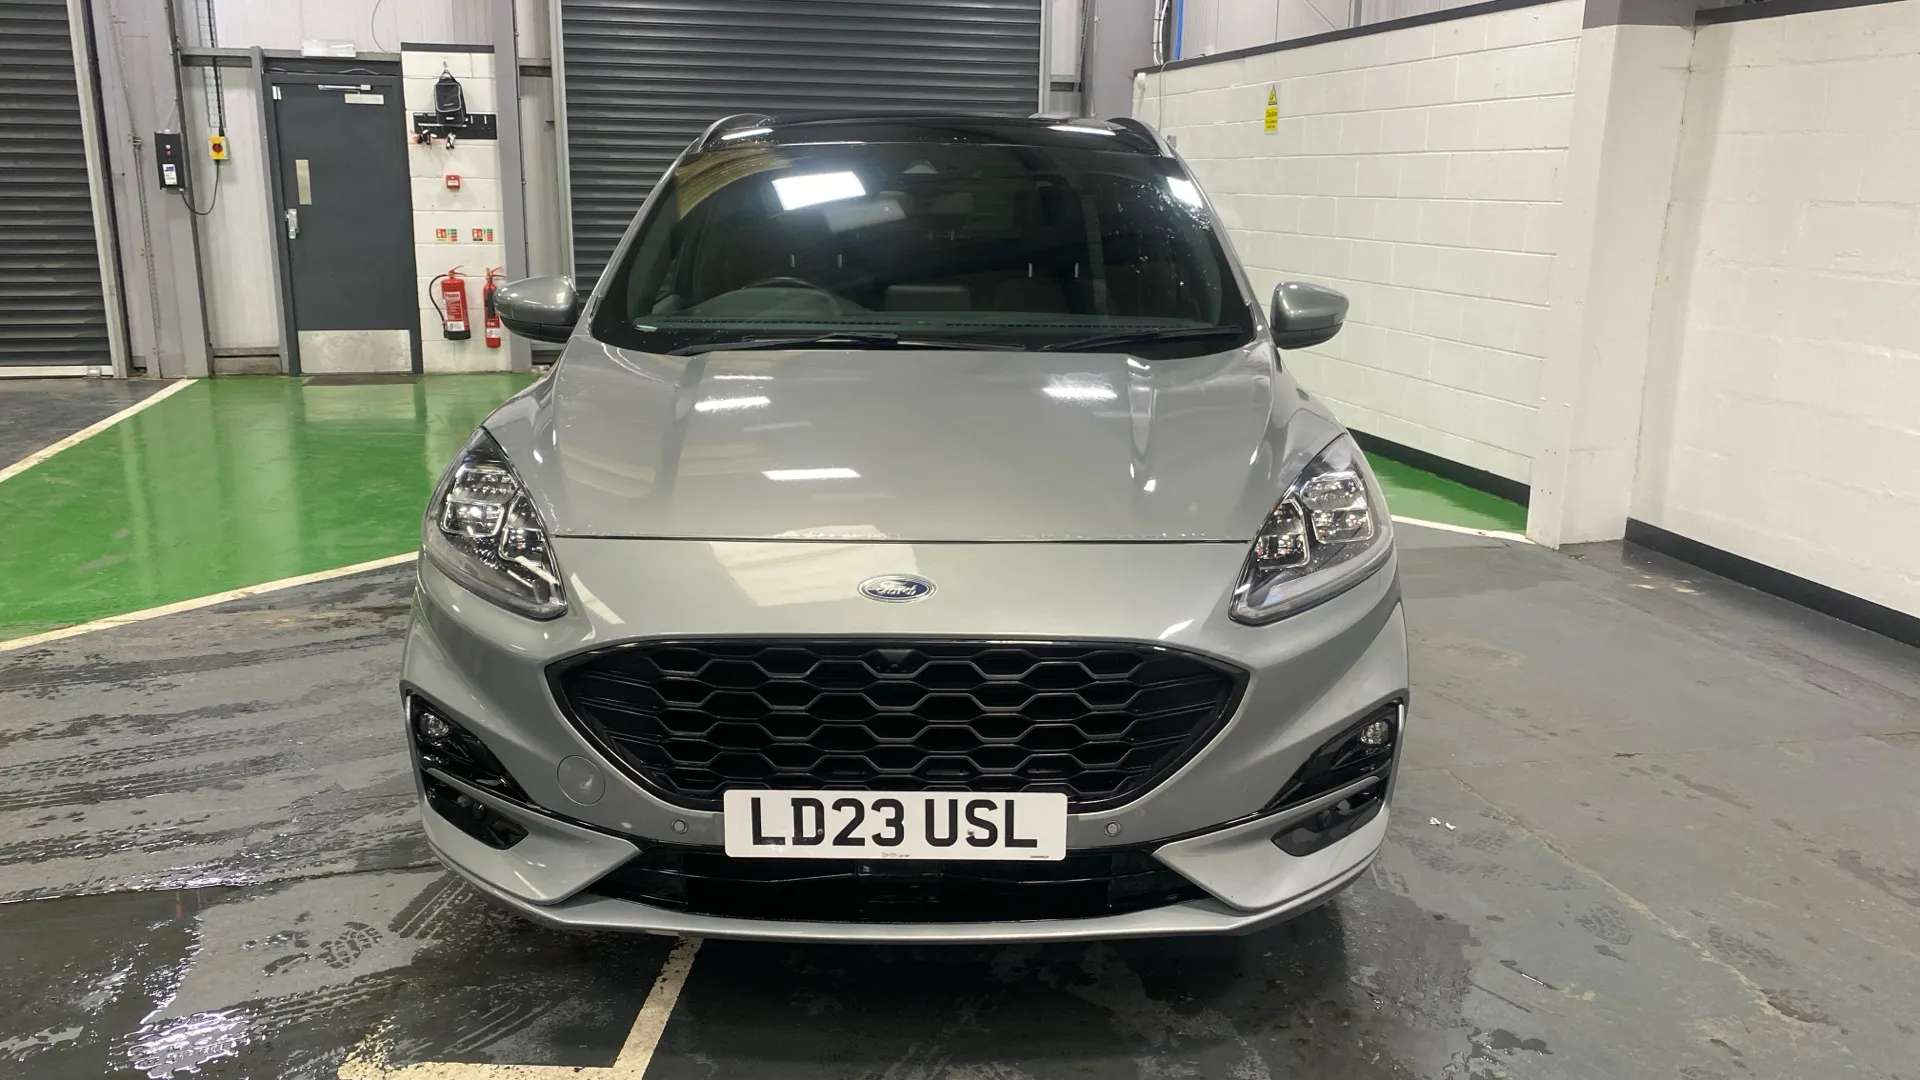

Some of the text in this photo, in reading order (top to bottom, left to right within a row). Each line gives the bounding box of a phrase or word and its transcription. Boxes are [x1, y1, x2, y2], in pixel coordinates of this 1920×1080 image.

[878, 580, 917, 595] Ford
[751, 797, 1038, 849] LD23 USL
